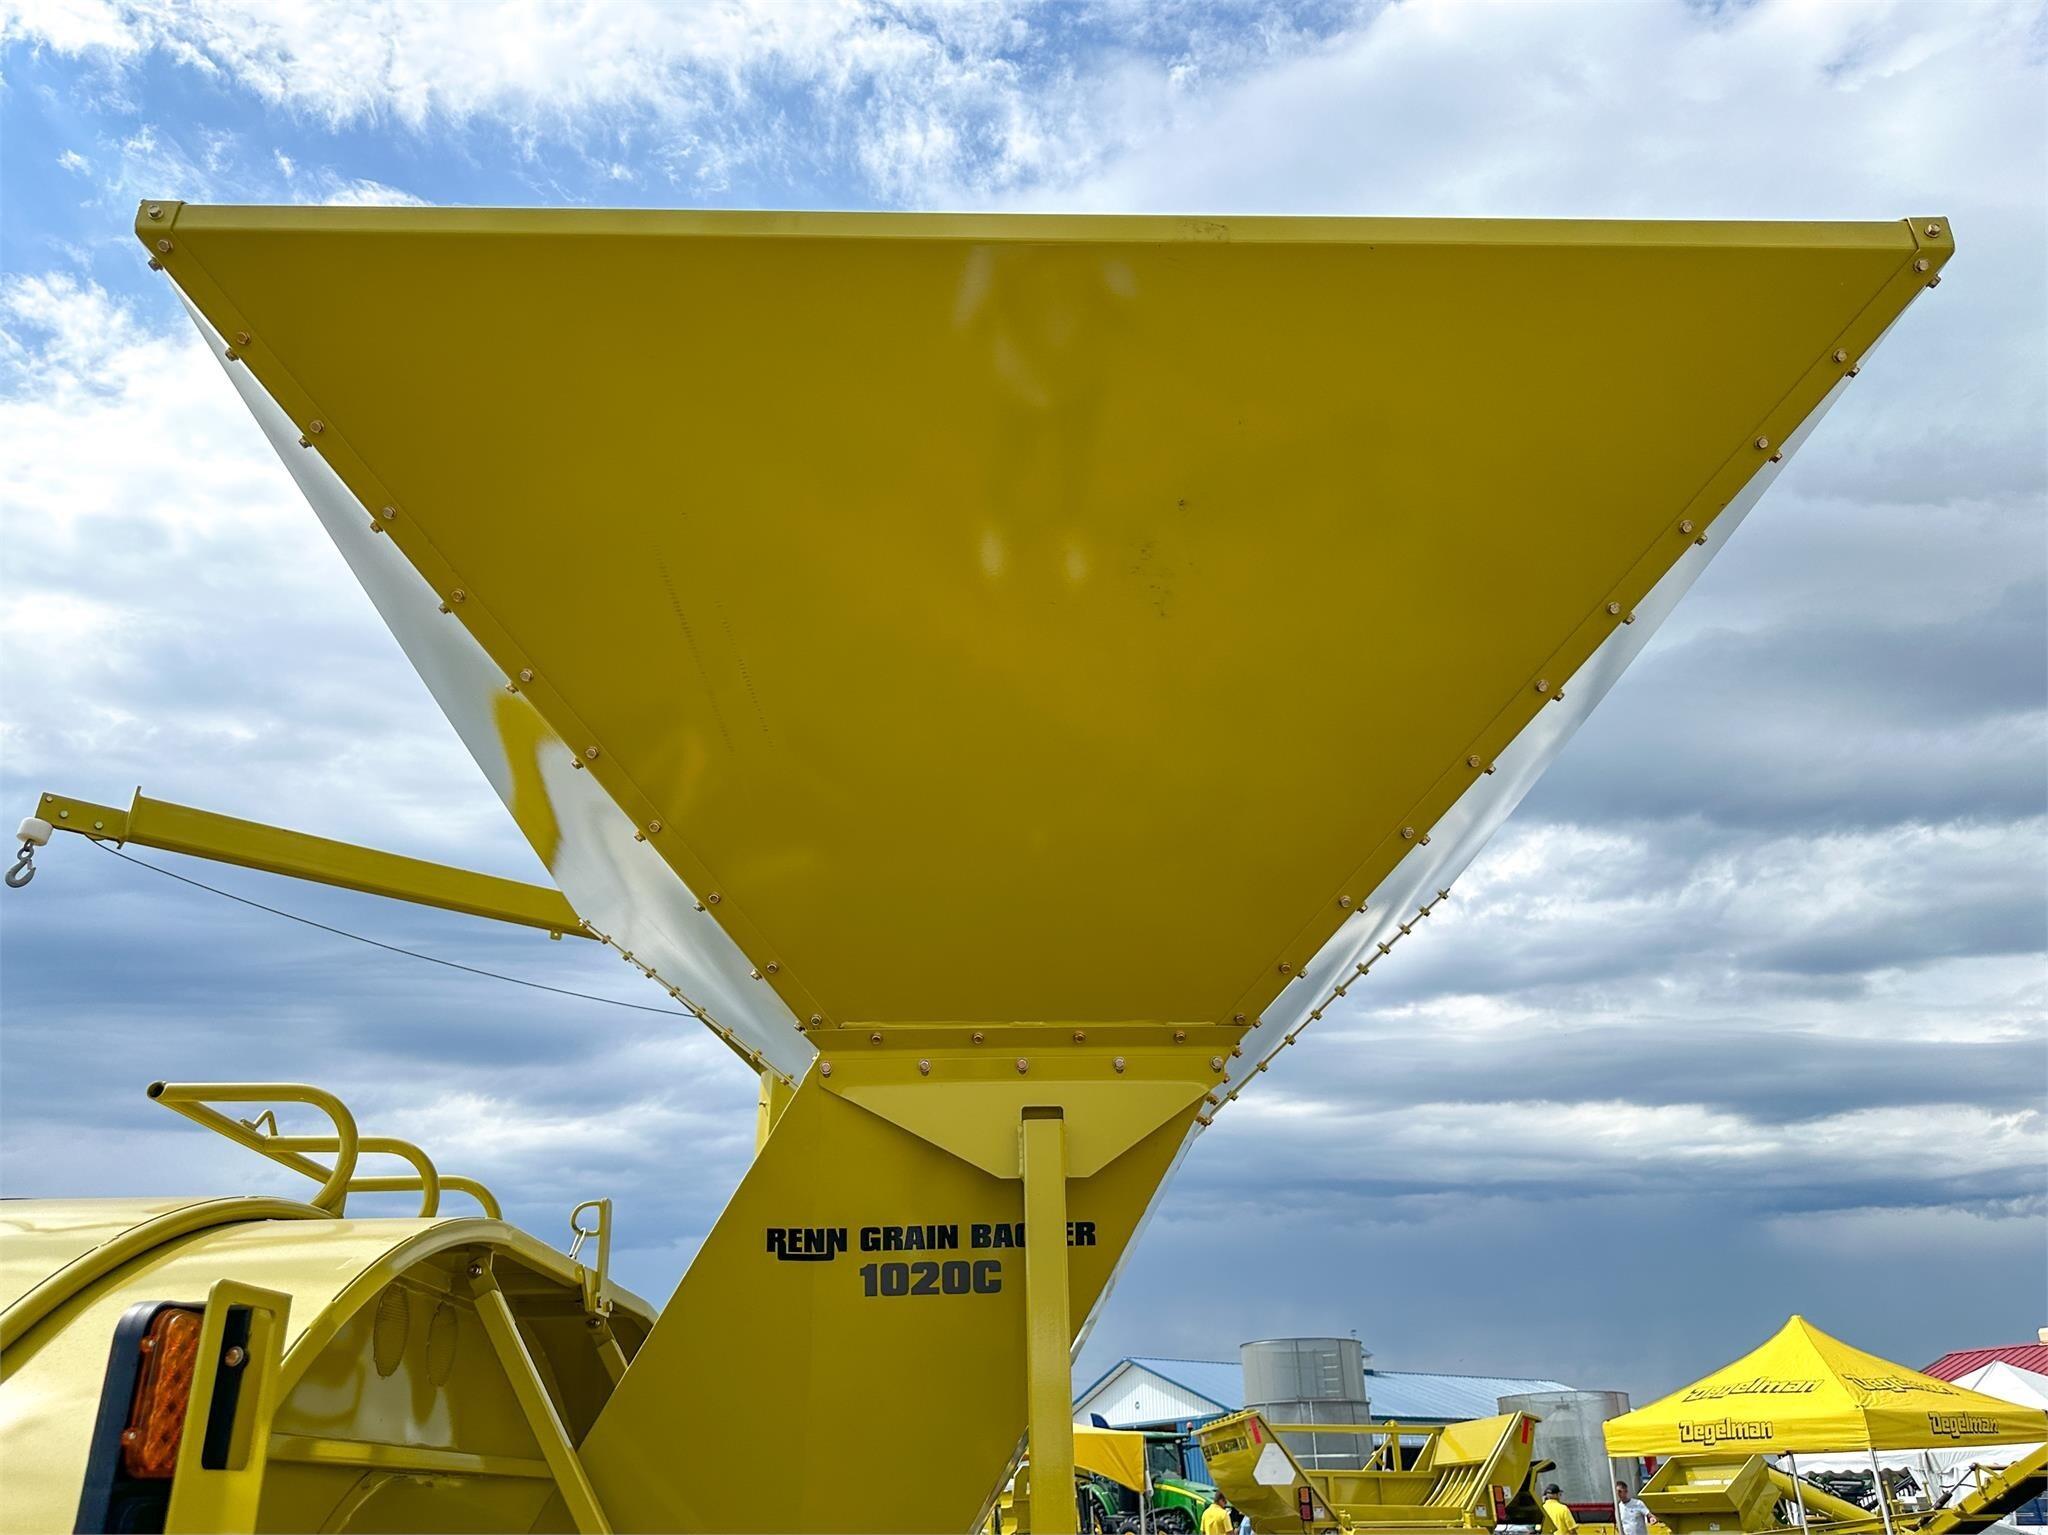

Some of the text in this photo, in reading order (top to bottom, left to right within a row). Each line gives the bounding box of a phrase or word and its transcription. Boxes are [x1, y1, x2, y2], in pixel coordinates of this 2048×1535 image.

[766, 1222, 1096, 1261] RENN GRAIN BAR
[860, 1260, 1001, 1296] 1020C
[1679, 1417, 1773, 1446] Degelman
[1929, 1411, 1999, 1438] Degelman
